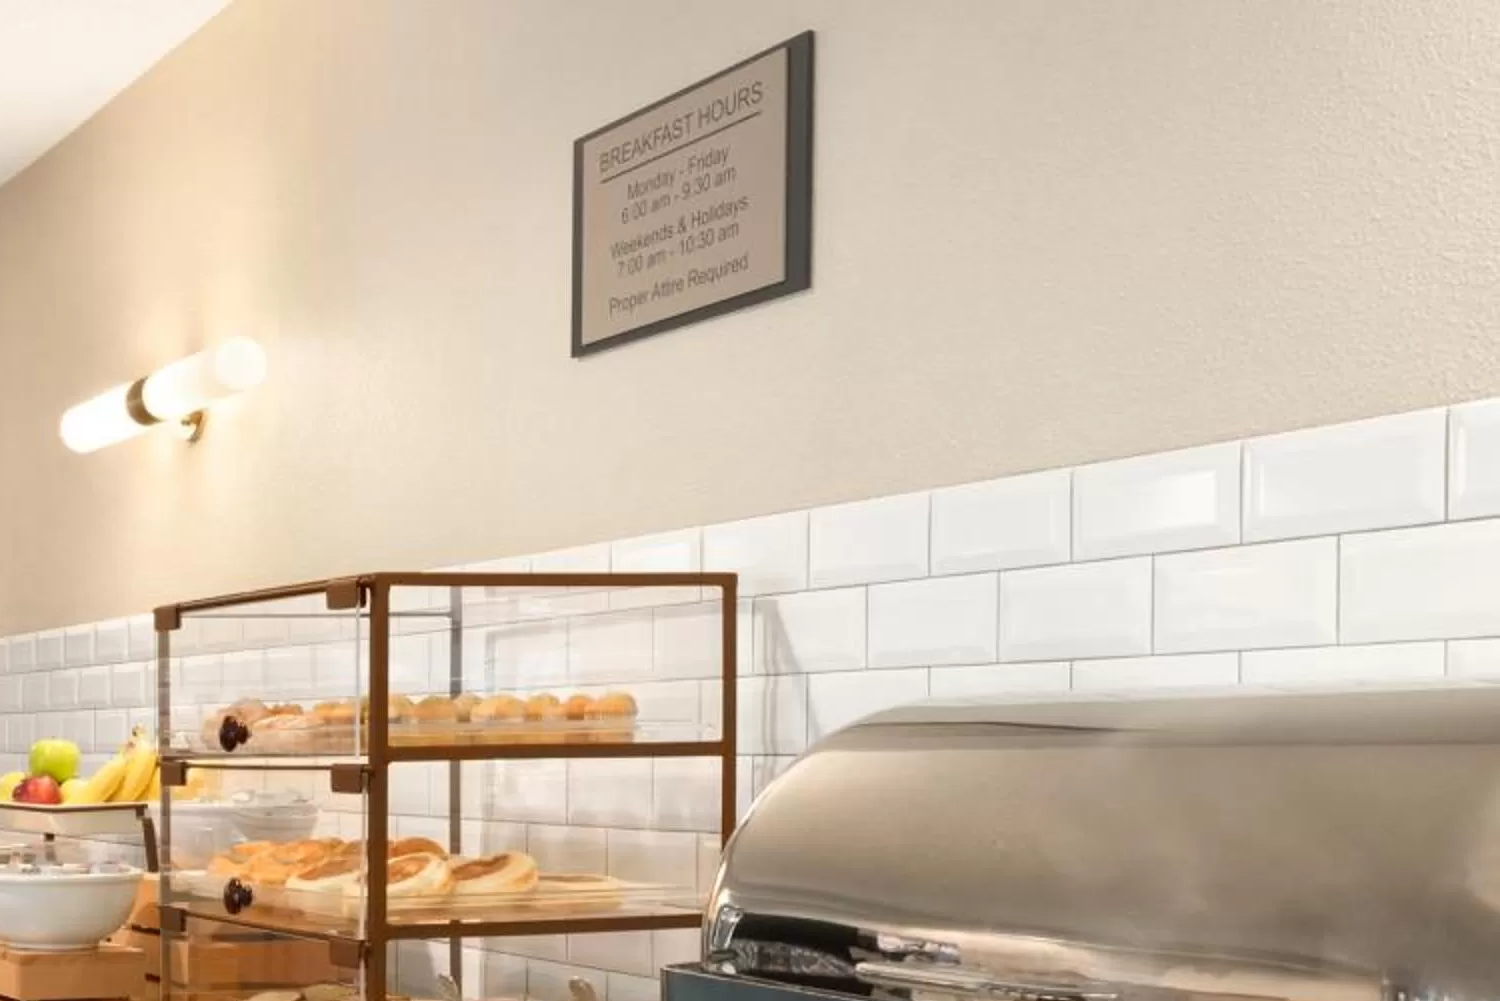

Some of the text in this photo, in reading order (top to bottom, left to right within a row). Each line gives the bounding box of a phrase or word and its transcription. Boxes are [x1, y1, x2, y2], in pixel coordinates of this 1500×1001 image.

[599, 81, 764, 173] BREAKFAST HOURS
[627, 170, 676, 200] Monday
[688, 144, 730, 175] Friday
[651, 194, 671, 213] am
[714, 166, 737, 188] am
[610, 196, 749, 261] Weekends & Holidays
[647, 249, 668, 269] am
[718, 222, 739, 243] am
[609, 250, 749, 319] Proper Attire Required
